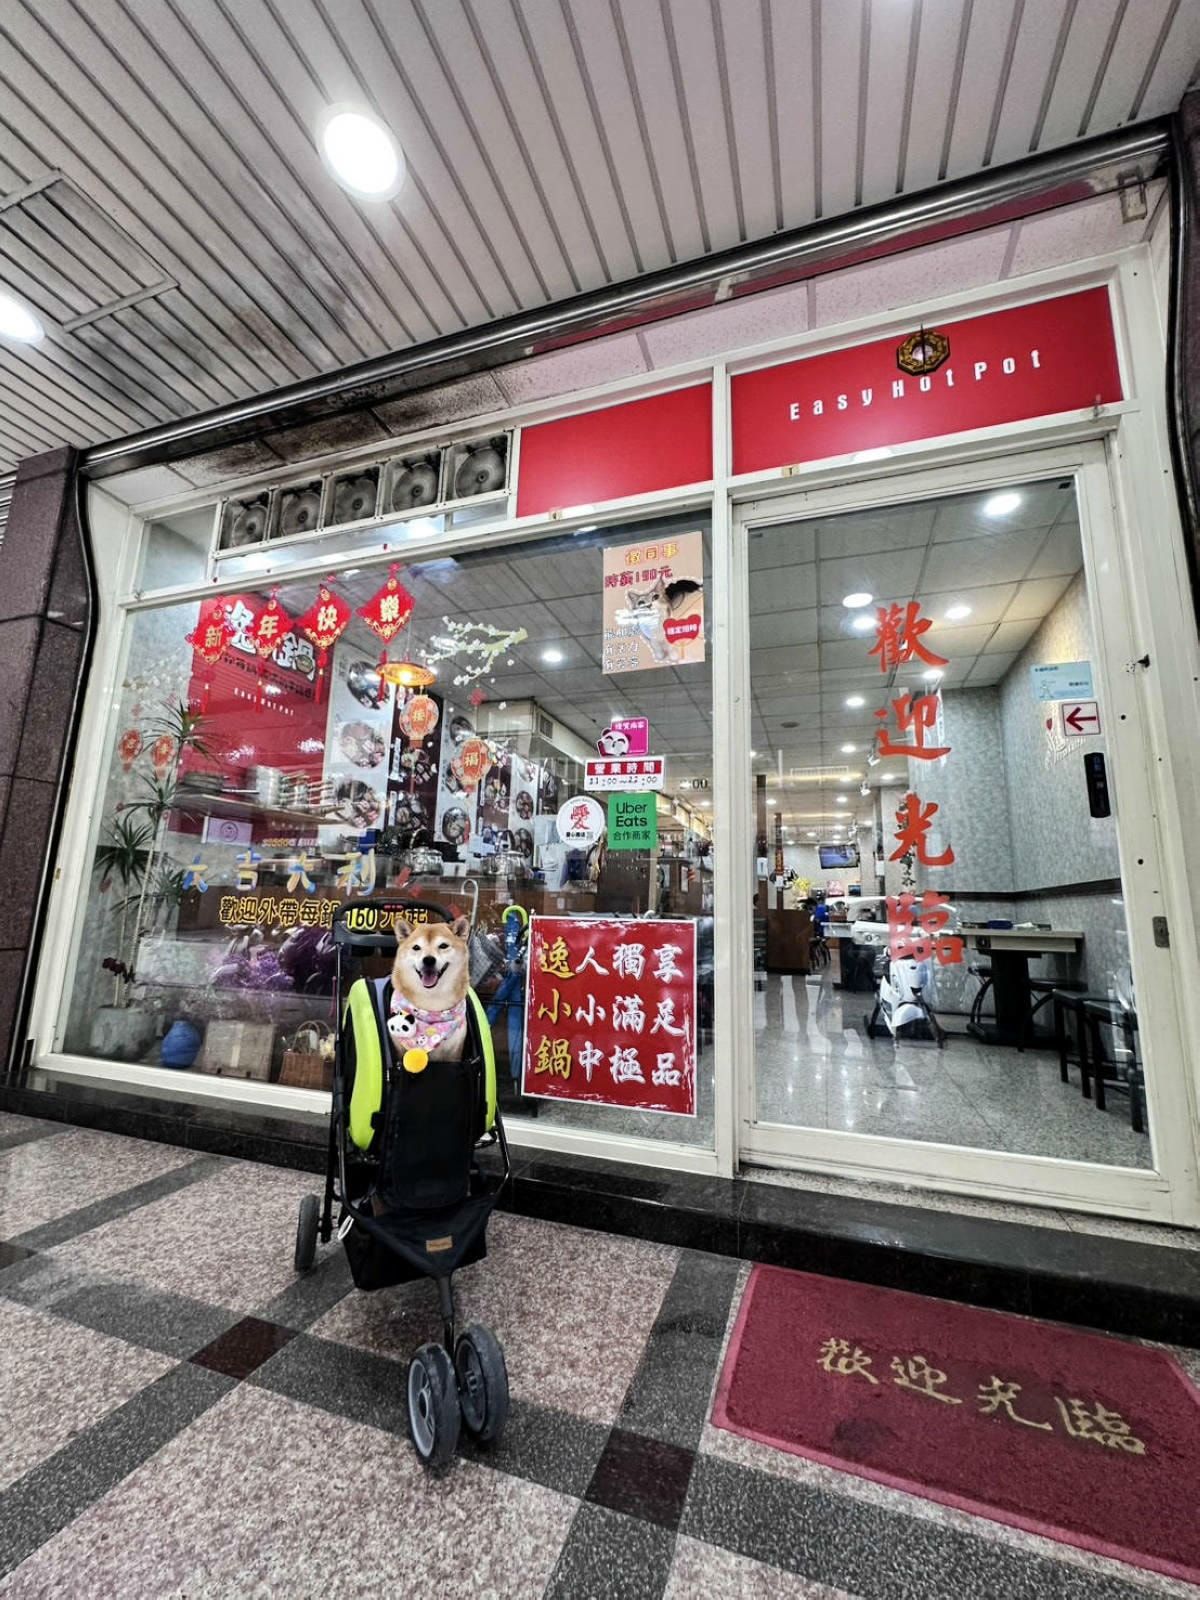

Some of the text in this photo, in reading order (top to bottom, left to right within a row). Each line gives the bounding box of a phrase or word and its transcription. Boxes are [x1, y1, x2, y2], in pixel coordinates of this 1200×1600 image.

[790, 388, 873, 421] Easy
[974, 350, 1041, 381] Pot
[594, 762, 655, 775] 營業時間
[868, 601, 964, 966] 歡迎光臨
[616, 802, 648, 814] Uber
[616, 816, 648, 828] Eats
[613, 830, 651, 841] 合作商家
[183, 848, 376, 896] 大吉大利
[538, 936, 685, 982] 逸人獨享
[536, 989, 686, 1036] 小小滿足
[534, 1036, 682, 1088] 鍋中極品
